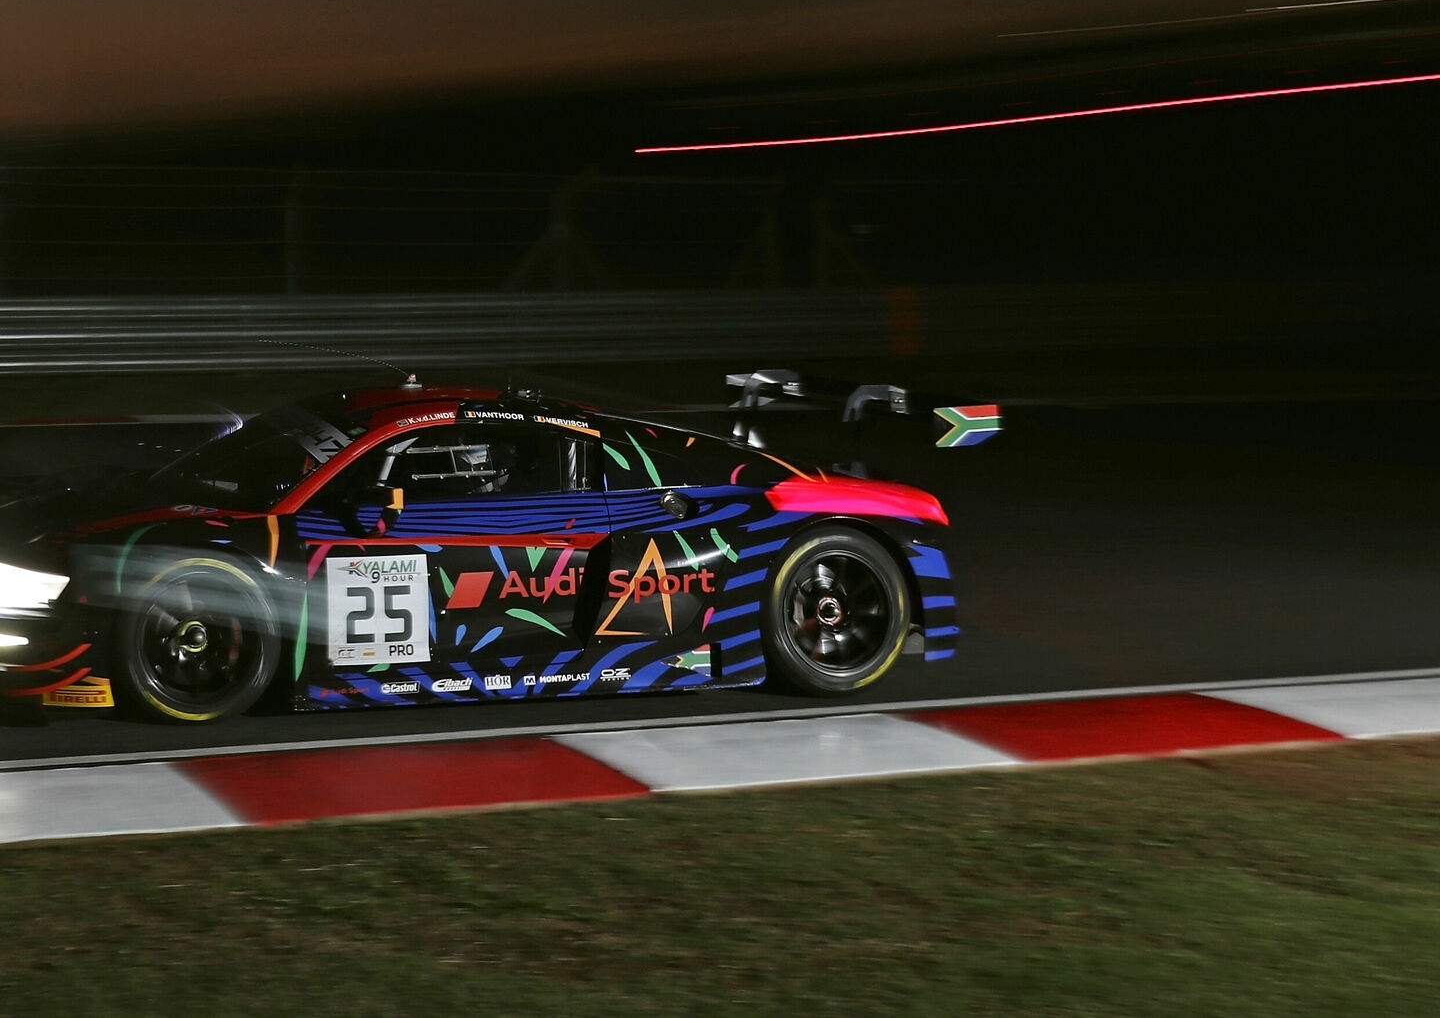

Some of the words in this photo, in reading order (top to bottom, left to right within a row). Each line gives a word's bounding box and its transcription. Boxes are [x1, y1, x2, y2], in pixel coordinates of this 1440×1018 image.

[475, 411, 525, 421] VANTHOOR
[544, 417, 589, 429] VERVISCH
[371, 571, 381, 584] 9
[383, 574, 415, 582] HOUR
[607, 568, 716, 604] Sport
[346, 585, 413, 644] 25
[389, 644, 415, 657] PRO
[539, 673, 591, 684] MONTAPLAST
[390, 682, 418, 693] Castrol
[49, 689, 107, 703] PIRELLI
